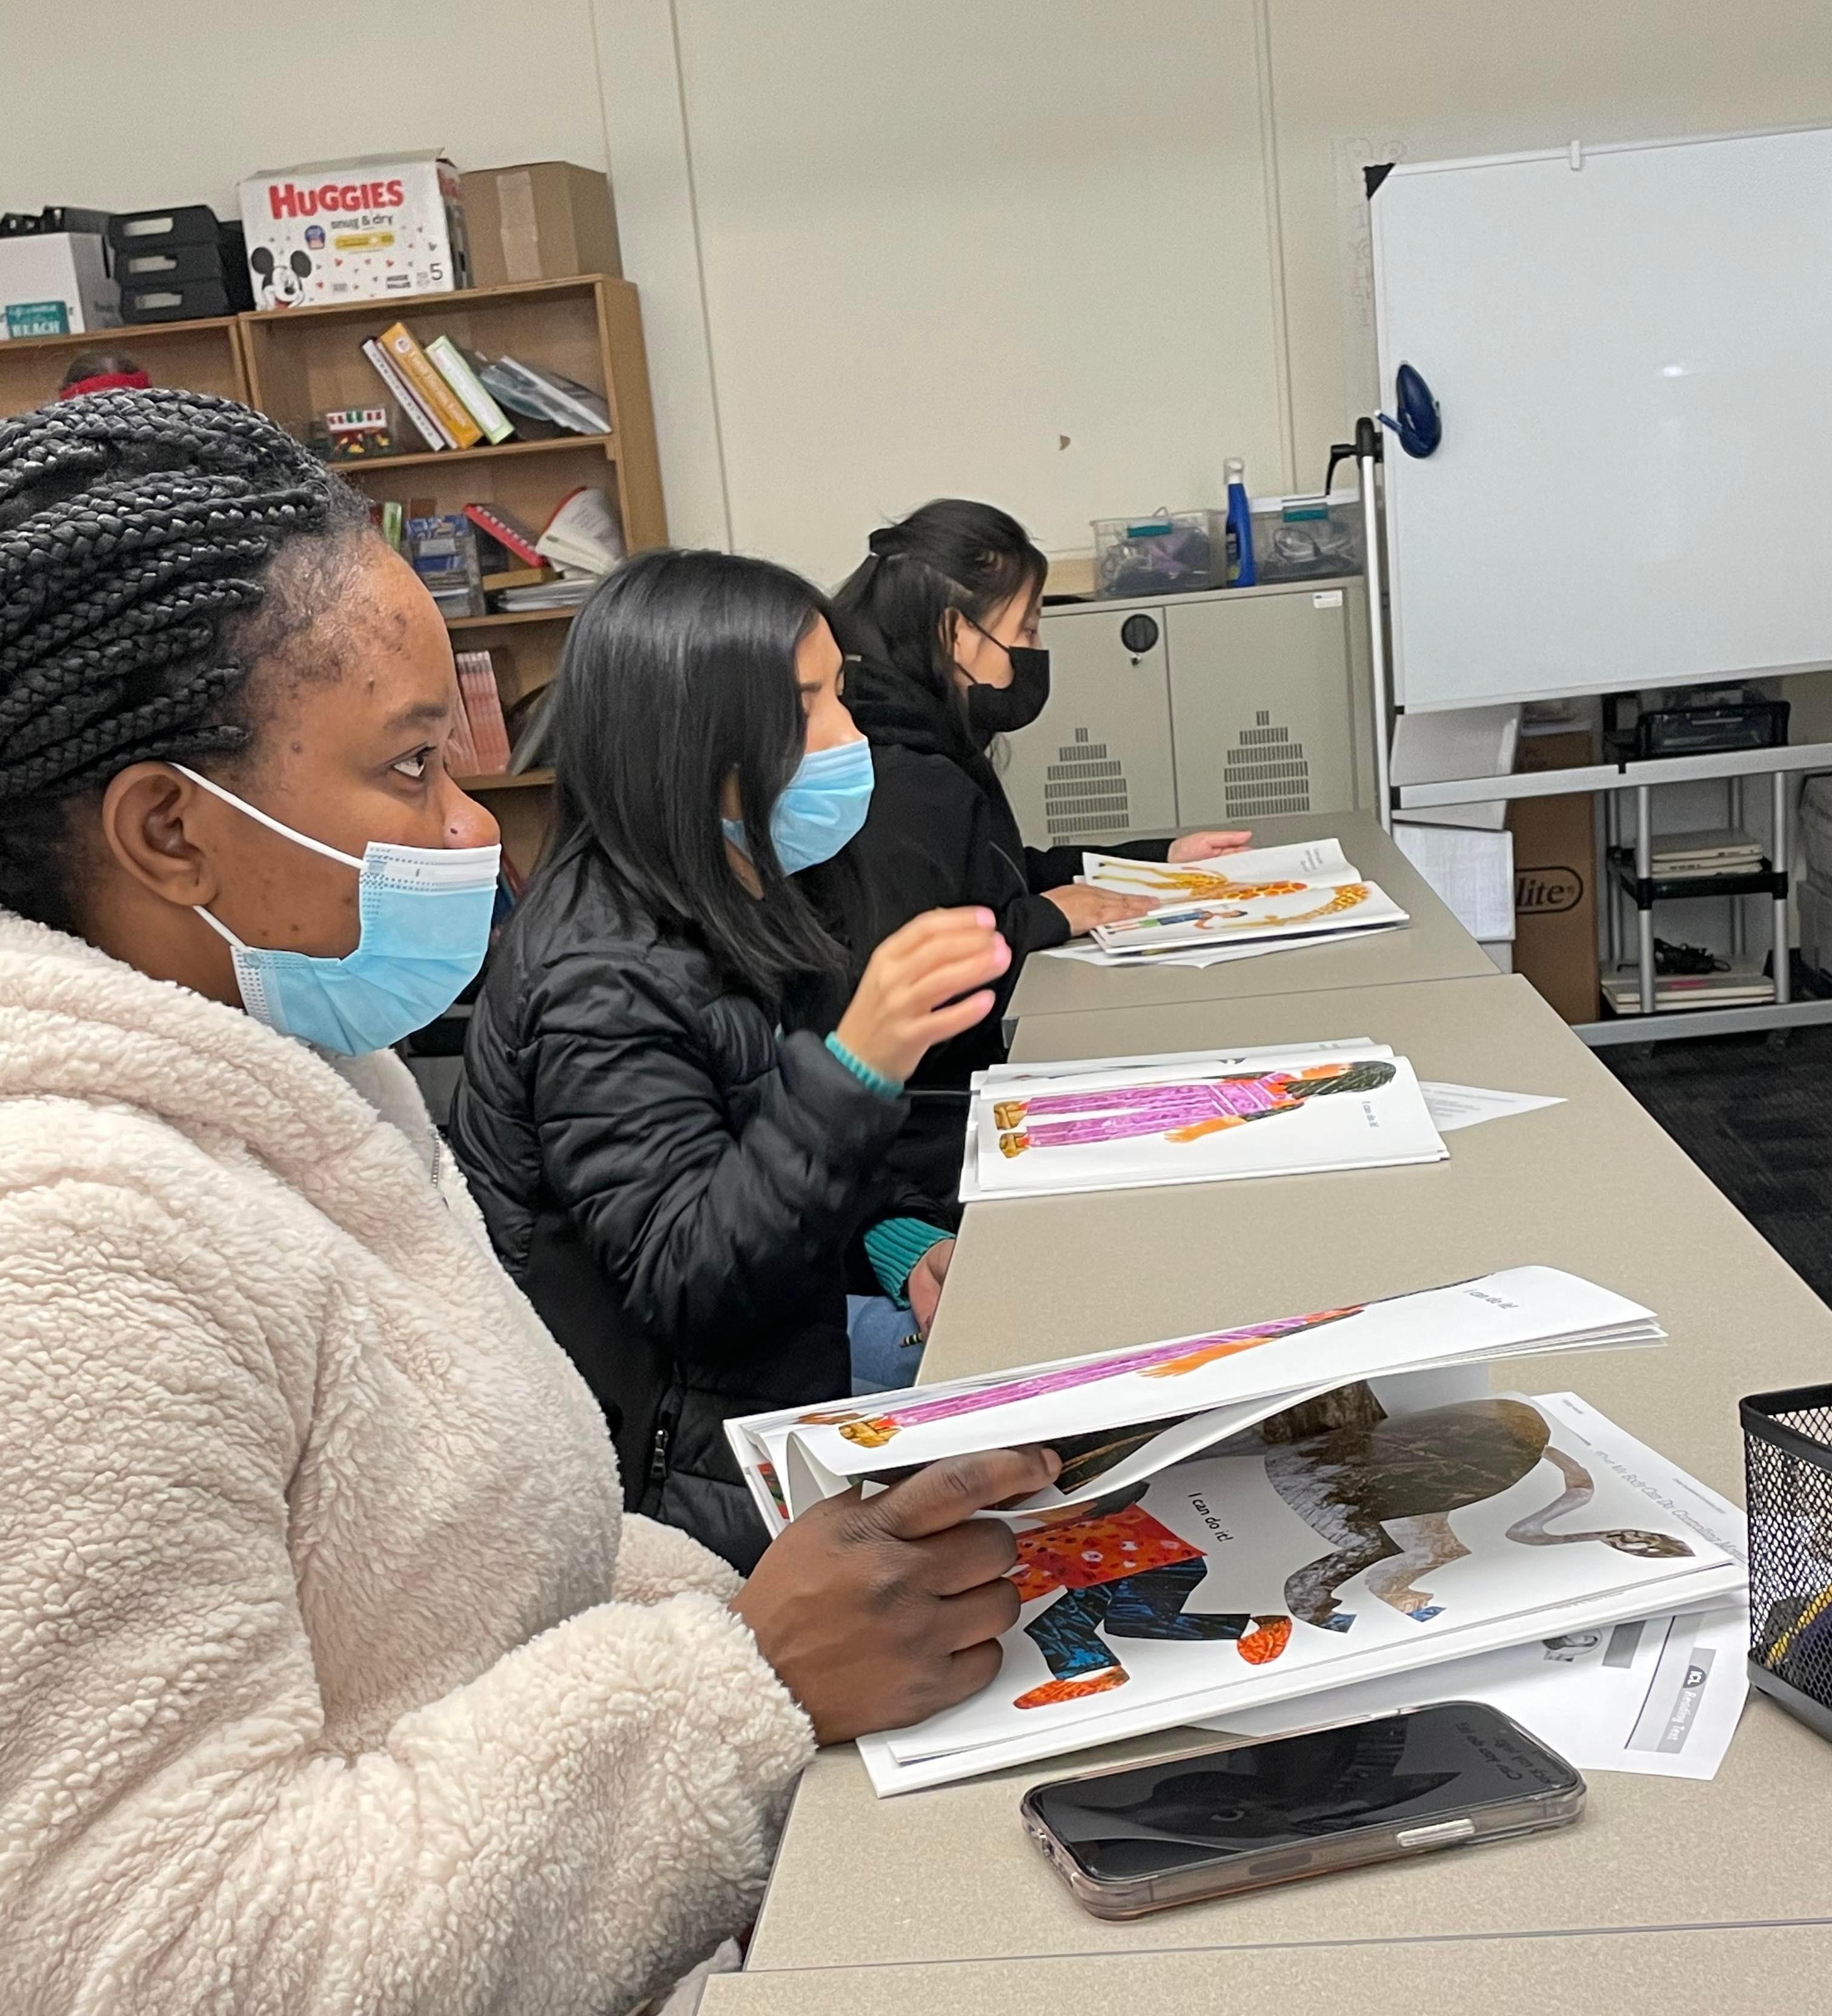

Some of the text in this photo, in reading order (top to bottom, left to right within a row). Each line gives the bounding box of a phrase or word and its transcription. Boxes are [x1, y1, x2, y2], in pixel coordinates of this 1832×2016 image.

[268, 179, 404, 219] HUGGIES
[373, 213, 393, 226] dry
[430, 262, 443, 281] 5
[1192, 1499, 1210, 1516] can
[1204, 1517, 1221, 1530] do
[1214, 1530, 1234, 1542] it!
[1687, 1671, 1702, 1685] ICL
[1667, 1691, 1697, 1740] Reading Text
